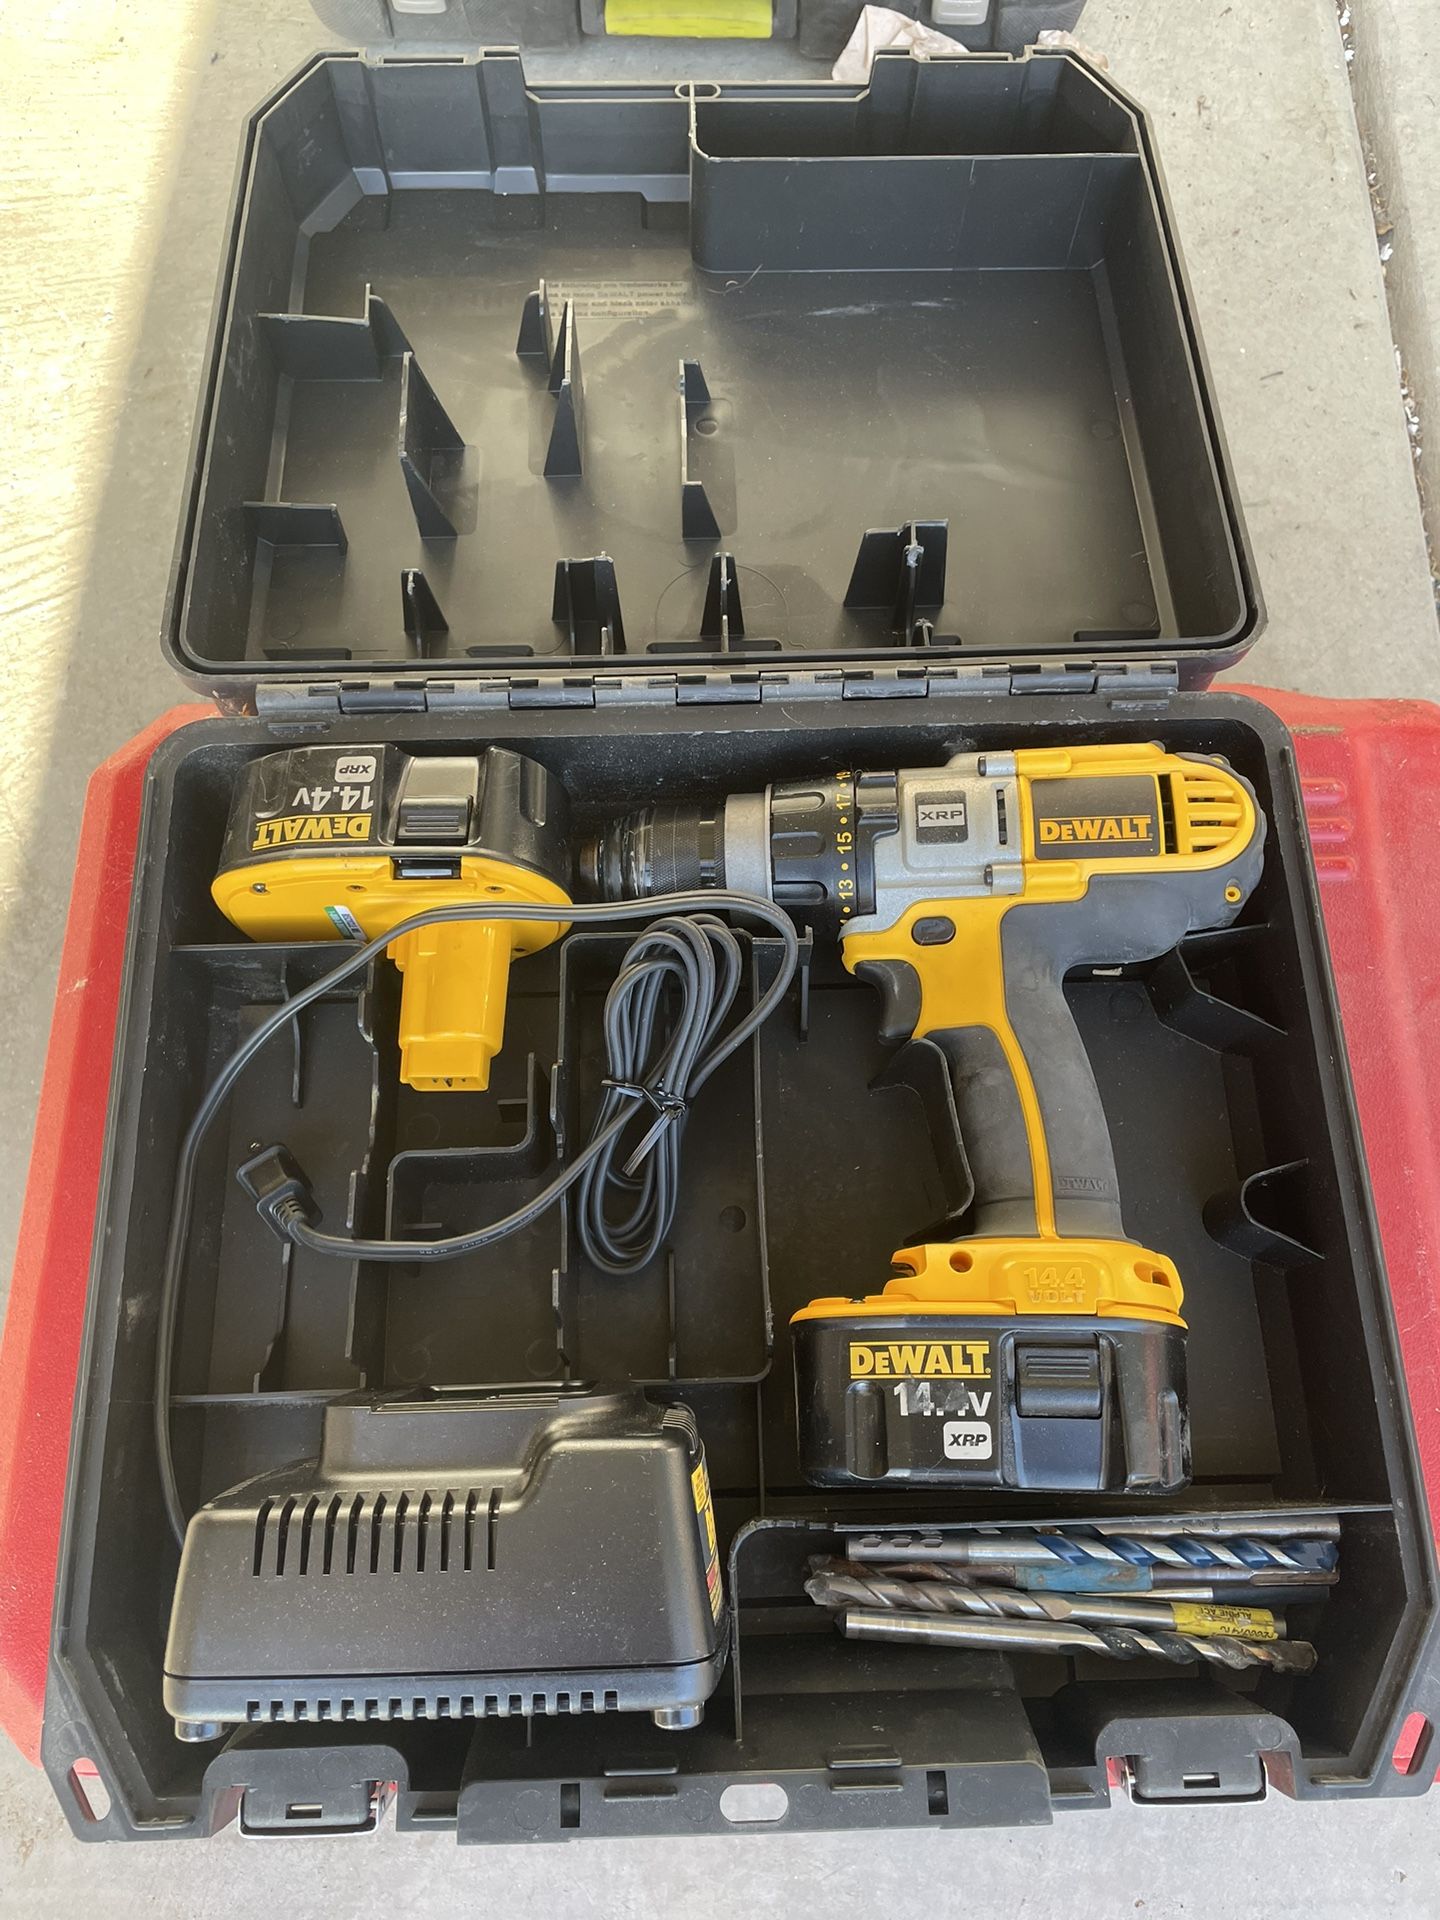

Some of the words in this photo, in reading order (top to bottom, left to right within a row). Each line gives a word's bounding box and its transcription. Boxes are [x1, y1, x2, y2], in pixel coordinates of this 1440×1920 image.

[339, 764, 371, 774] XRP
[836, 794, 851, 810] 17
[920, 810, 963, 821] XRP
[837, 831, 852, 854] 15
[838, 879, 854, 899] 13
[1023, 1267, 1086, 1288] 14.4
[1028, 1289, 1087, 1303] VOLT
[949, 1433, 988, 1447] XRP
